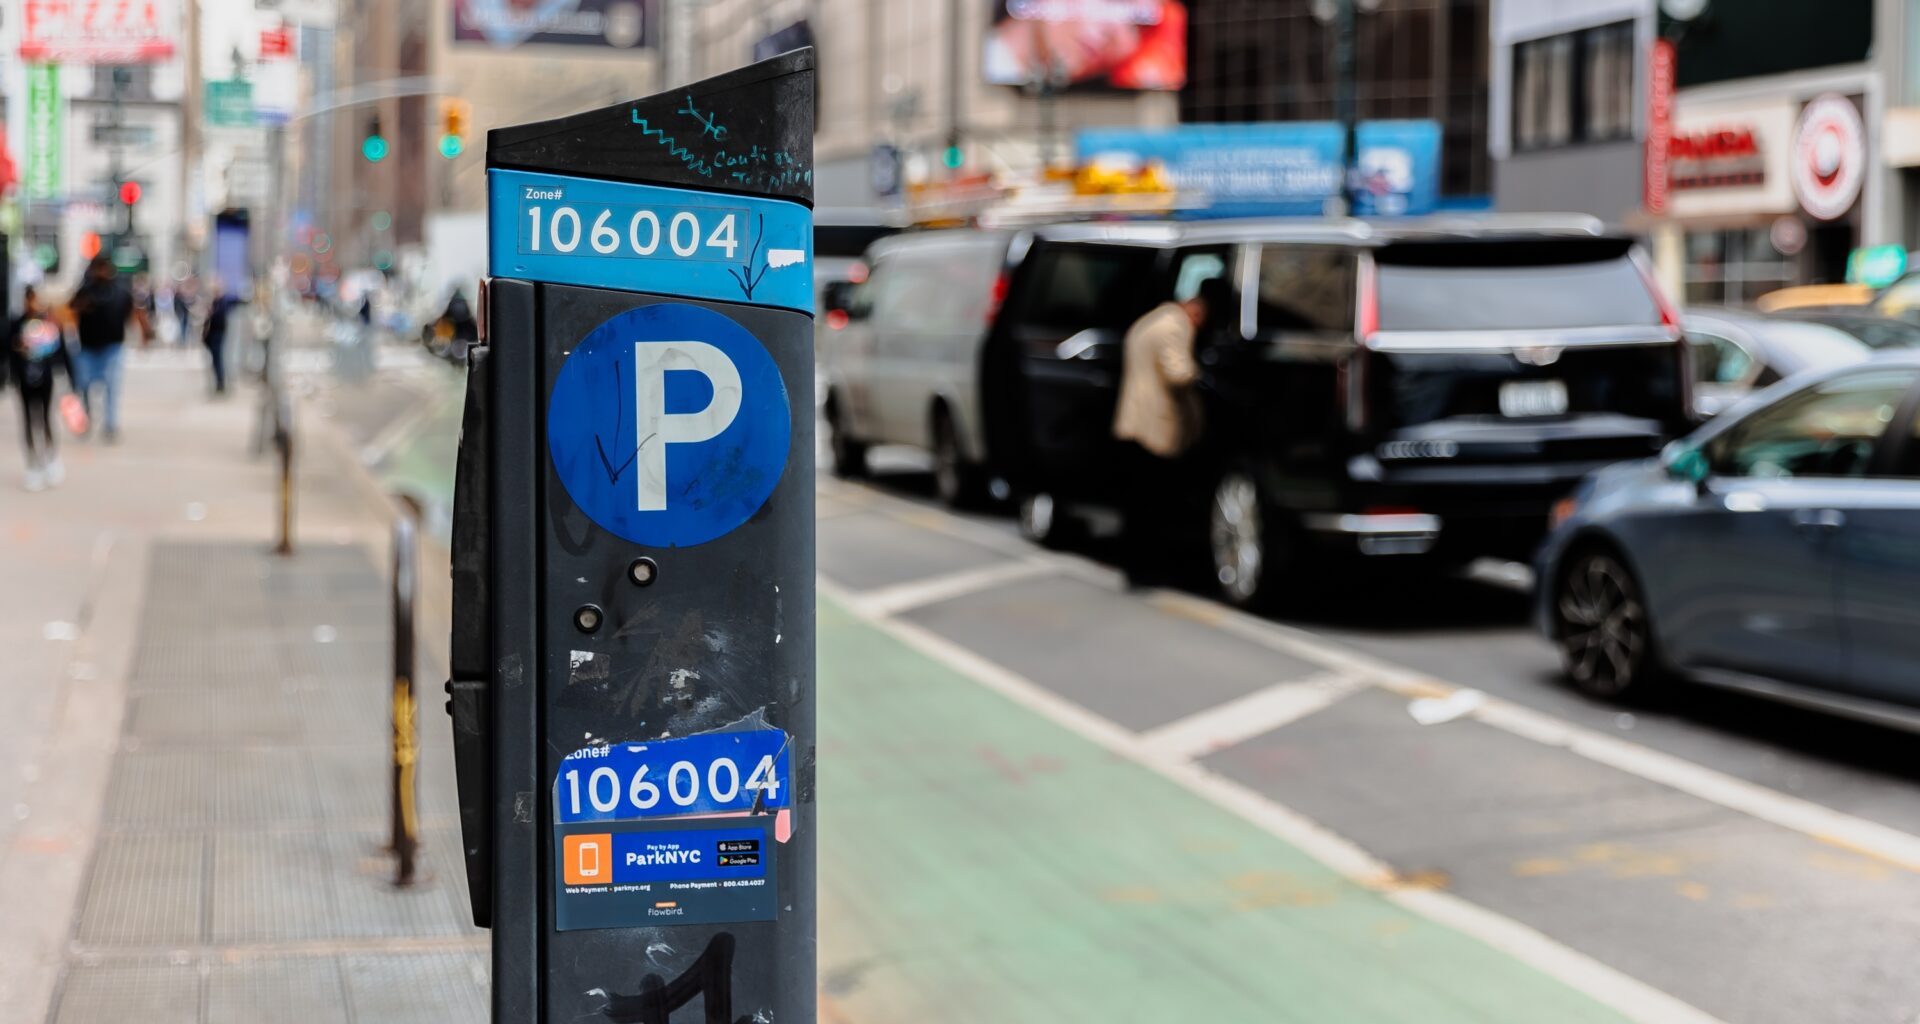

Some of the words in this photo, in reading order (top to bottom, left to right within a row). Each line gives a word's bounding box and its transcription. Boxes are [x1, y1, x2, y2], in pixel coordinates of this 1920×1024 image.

[525, 188, 563, 200] Zone#
[528, 206, 738, 258] 106004
[635, 341, 743, 511] P
[566, 754, 780, 814] 106004
[626, 849, 701, 866] ParkNYC
[580, 886, 608, 895] Payment
[690, 881, 717, 890] Payment
